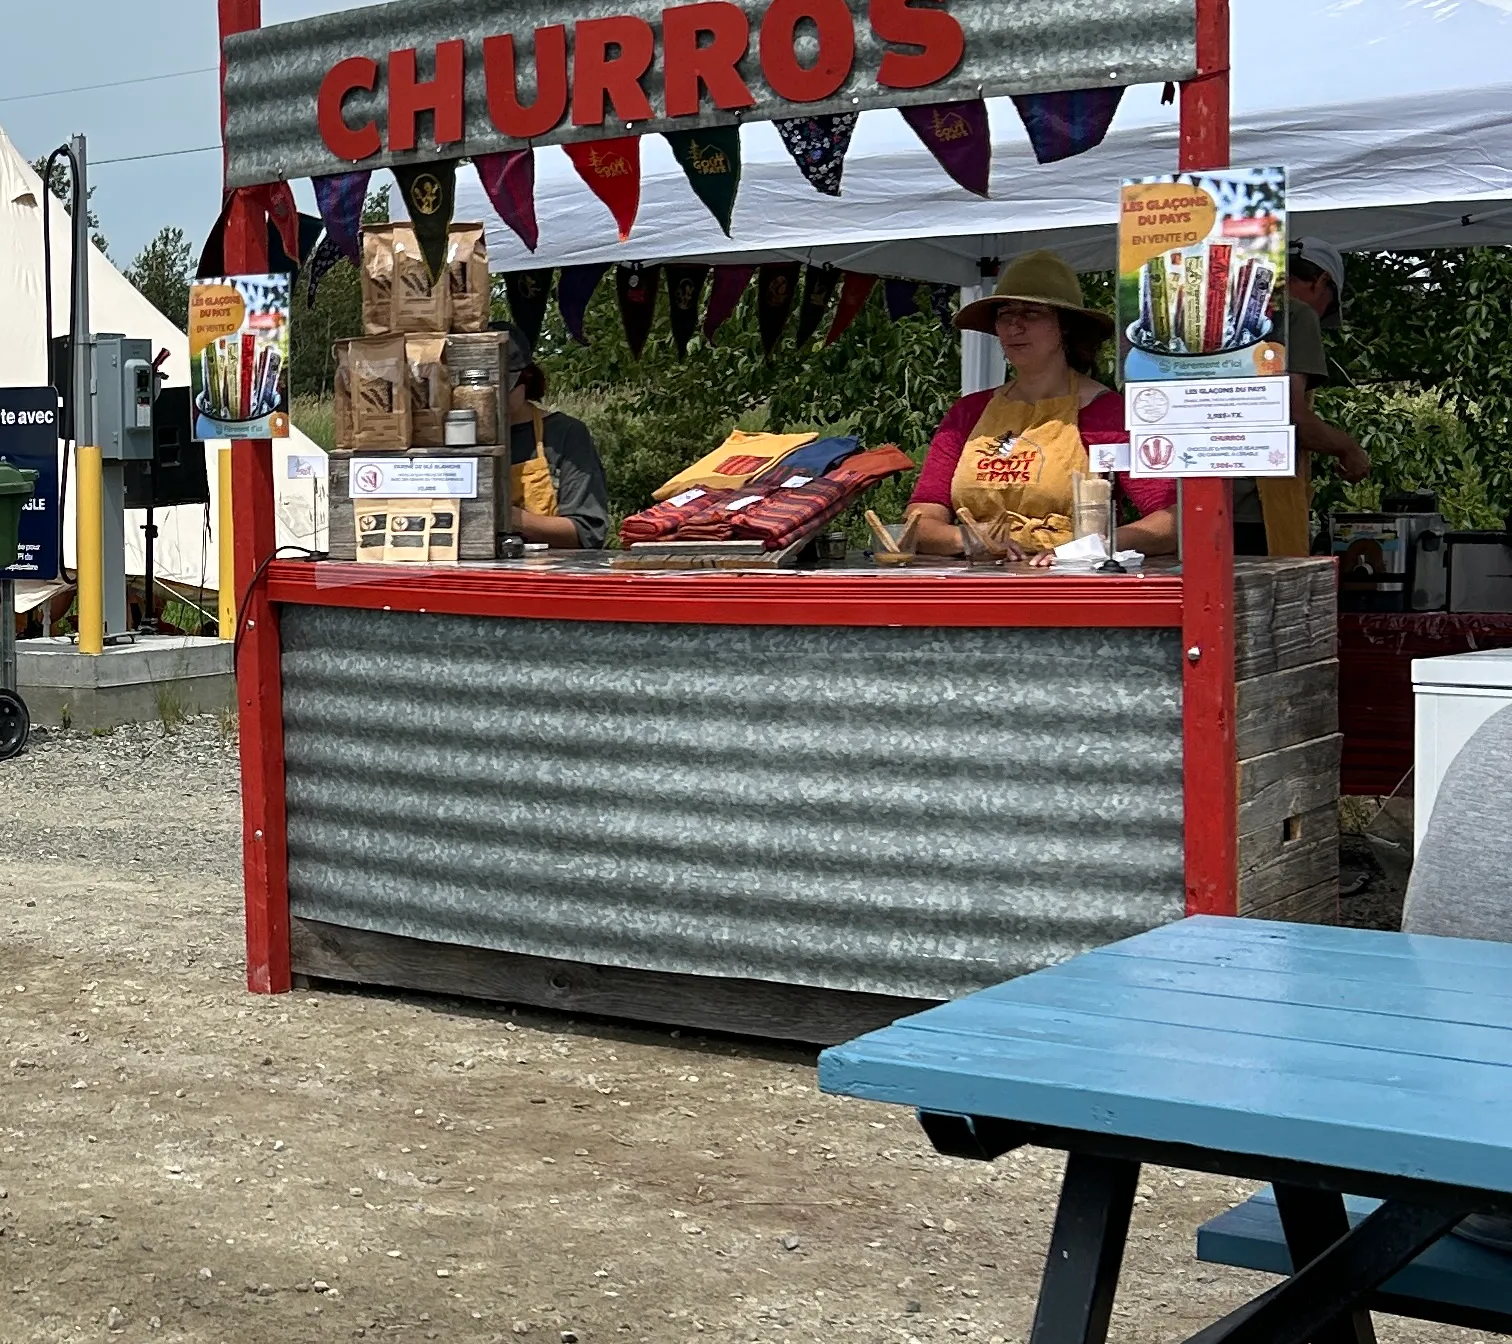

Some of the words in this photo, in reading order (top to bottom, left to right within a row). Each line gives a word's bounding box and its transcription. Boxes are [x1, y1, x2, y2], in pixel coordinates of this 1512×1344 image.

[1122, 200, 1144, 213] LES
[1146, 195, 1208, 211] GLAÇONS
[1138, 215, 1156, 226] DU
[1159, 212, 1191, 224] PAYS
[1132, 235, 1146, 245] EN
[1147, 232, 1181, 244] VENTE
[1183, 231, 1198, 242] ICI
[191, 297, 204, 306] LES
[204, 294, 240, 306] GLAÇONS
[200, 309, 211, 318] DU
[212, 307, 231, 317] PAYS
[18, 410, 54, 425] avec
[989, 471, 1031, 483] PAYS
